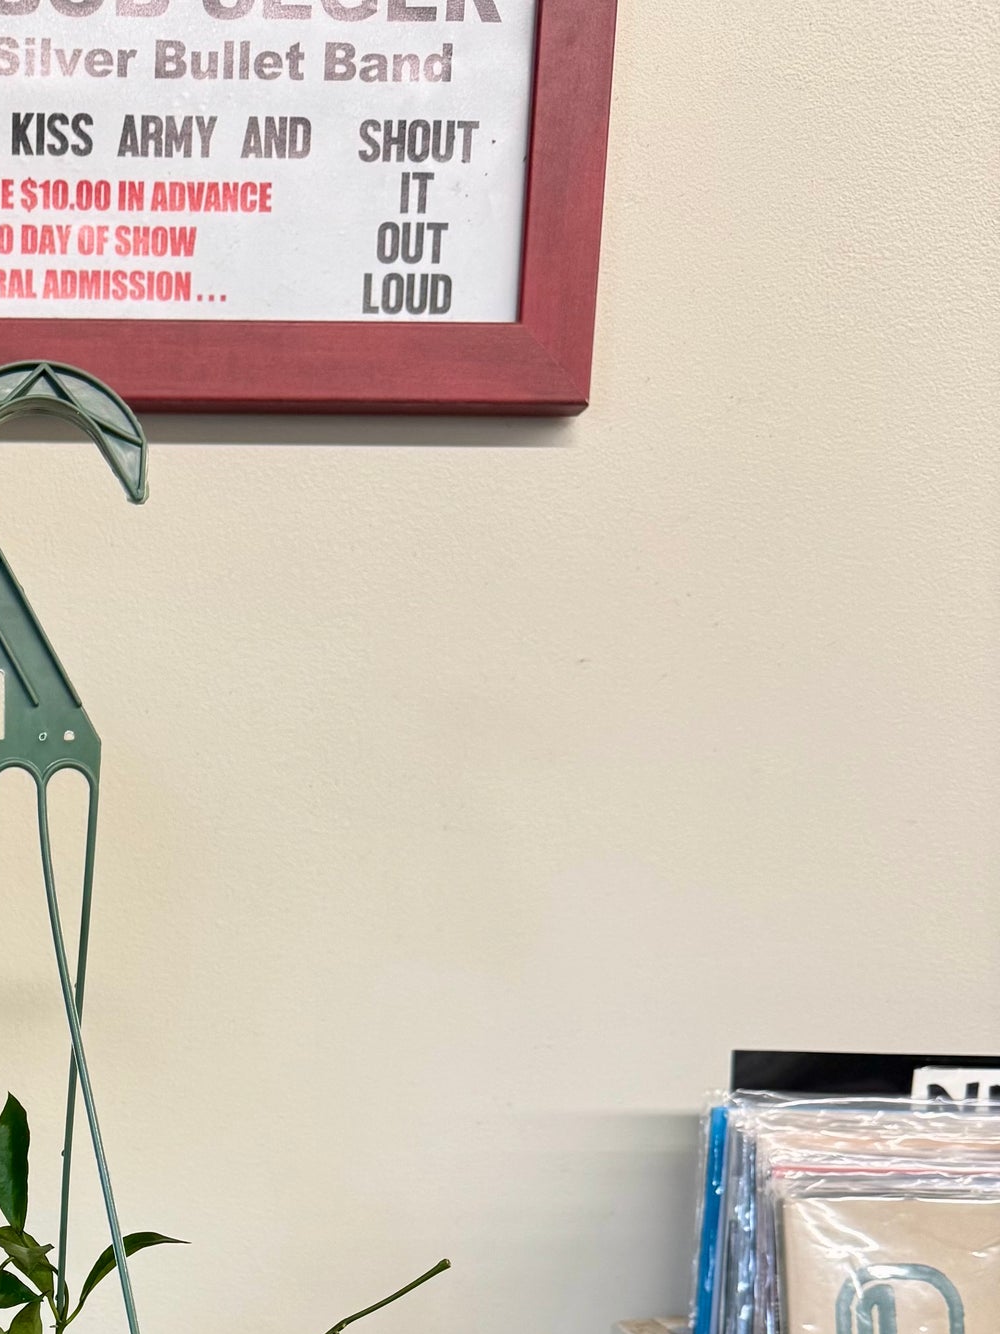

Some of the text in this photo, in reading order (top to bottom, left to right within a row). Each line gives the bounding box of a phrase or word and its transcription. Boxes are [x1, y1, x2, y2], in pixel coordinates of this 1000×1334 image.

[155, 39, 304, 81] Bullet
[324, 41, 453, 82] Band
[12, 112, 93, 156] KISS
[117, 114, 217, 158] ARMY
[241, 116, 311, 159] AND
[358, 119, 479, 163] SHOUT
[20, 178, 111, 212] $10.00
[118, 180, 144, 211] IN
[152, 181, 273, 213] ADVANCE
[400, 172, 434, 214] IT
[21, 225, 71, 256] DAY
[77, 226, 109, 256] OF
[115, 226, 197, 257] SHOW
[376, 221, 449, 264] OUT
[362, 272, 452, 315] LOUD
